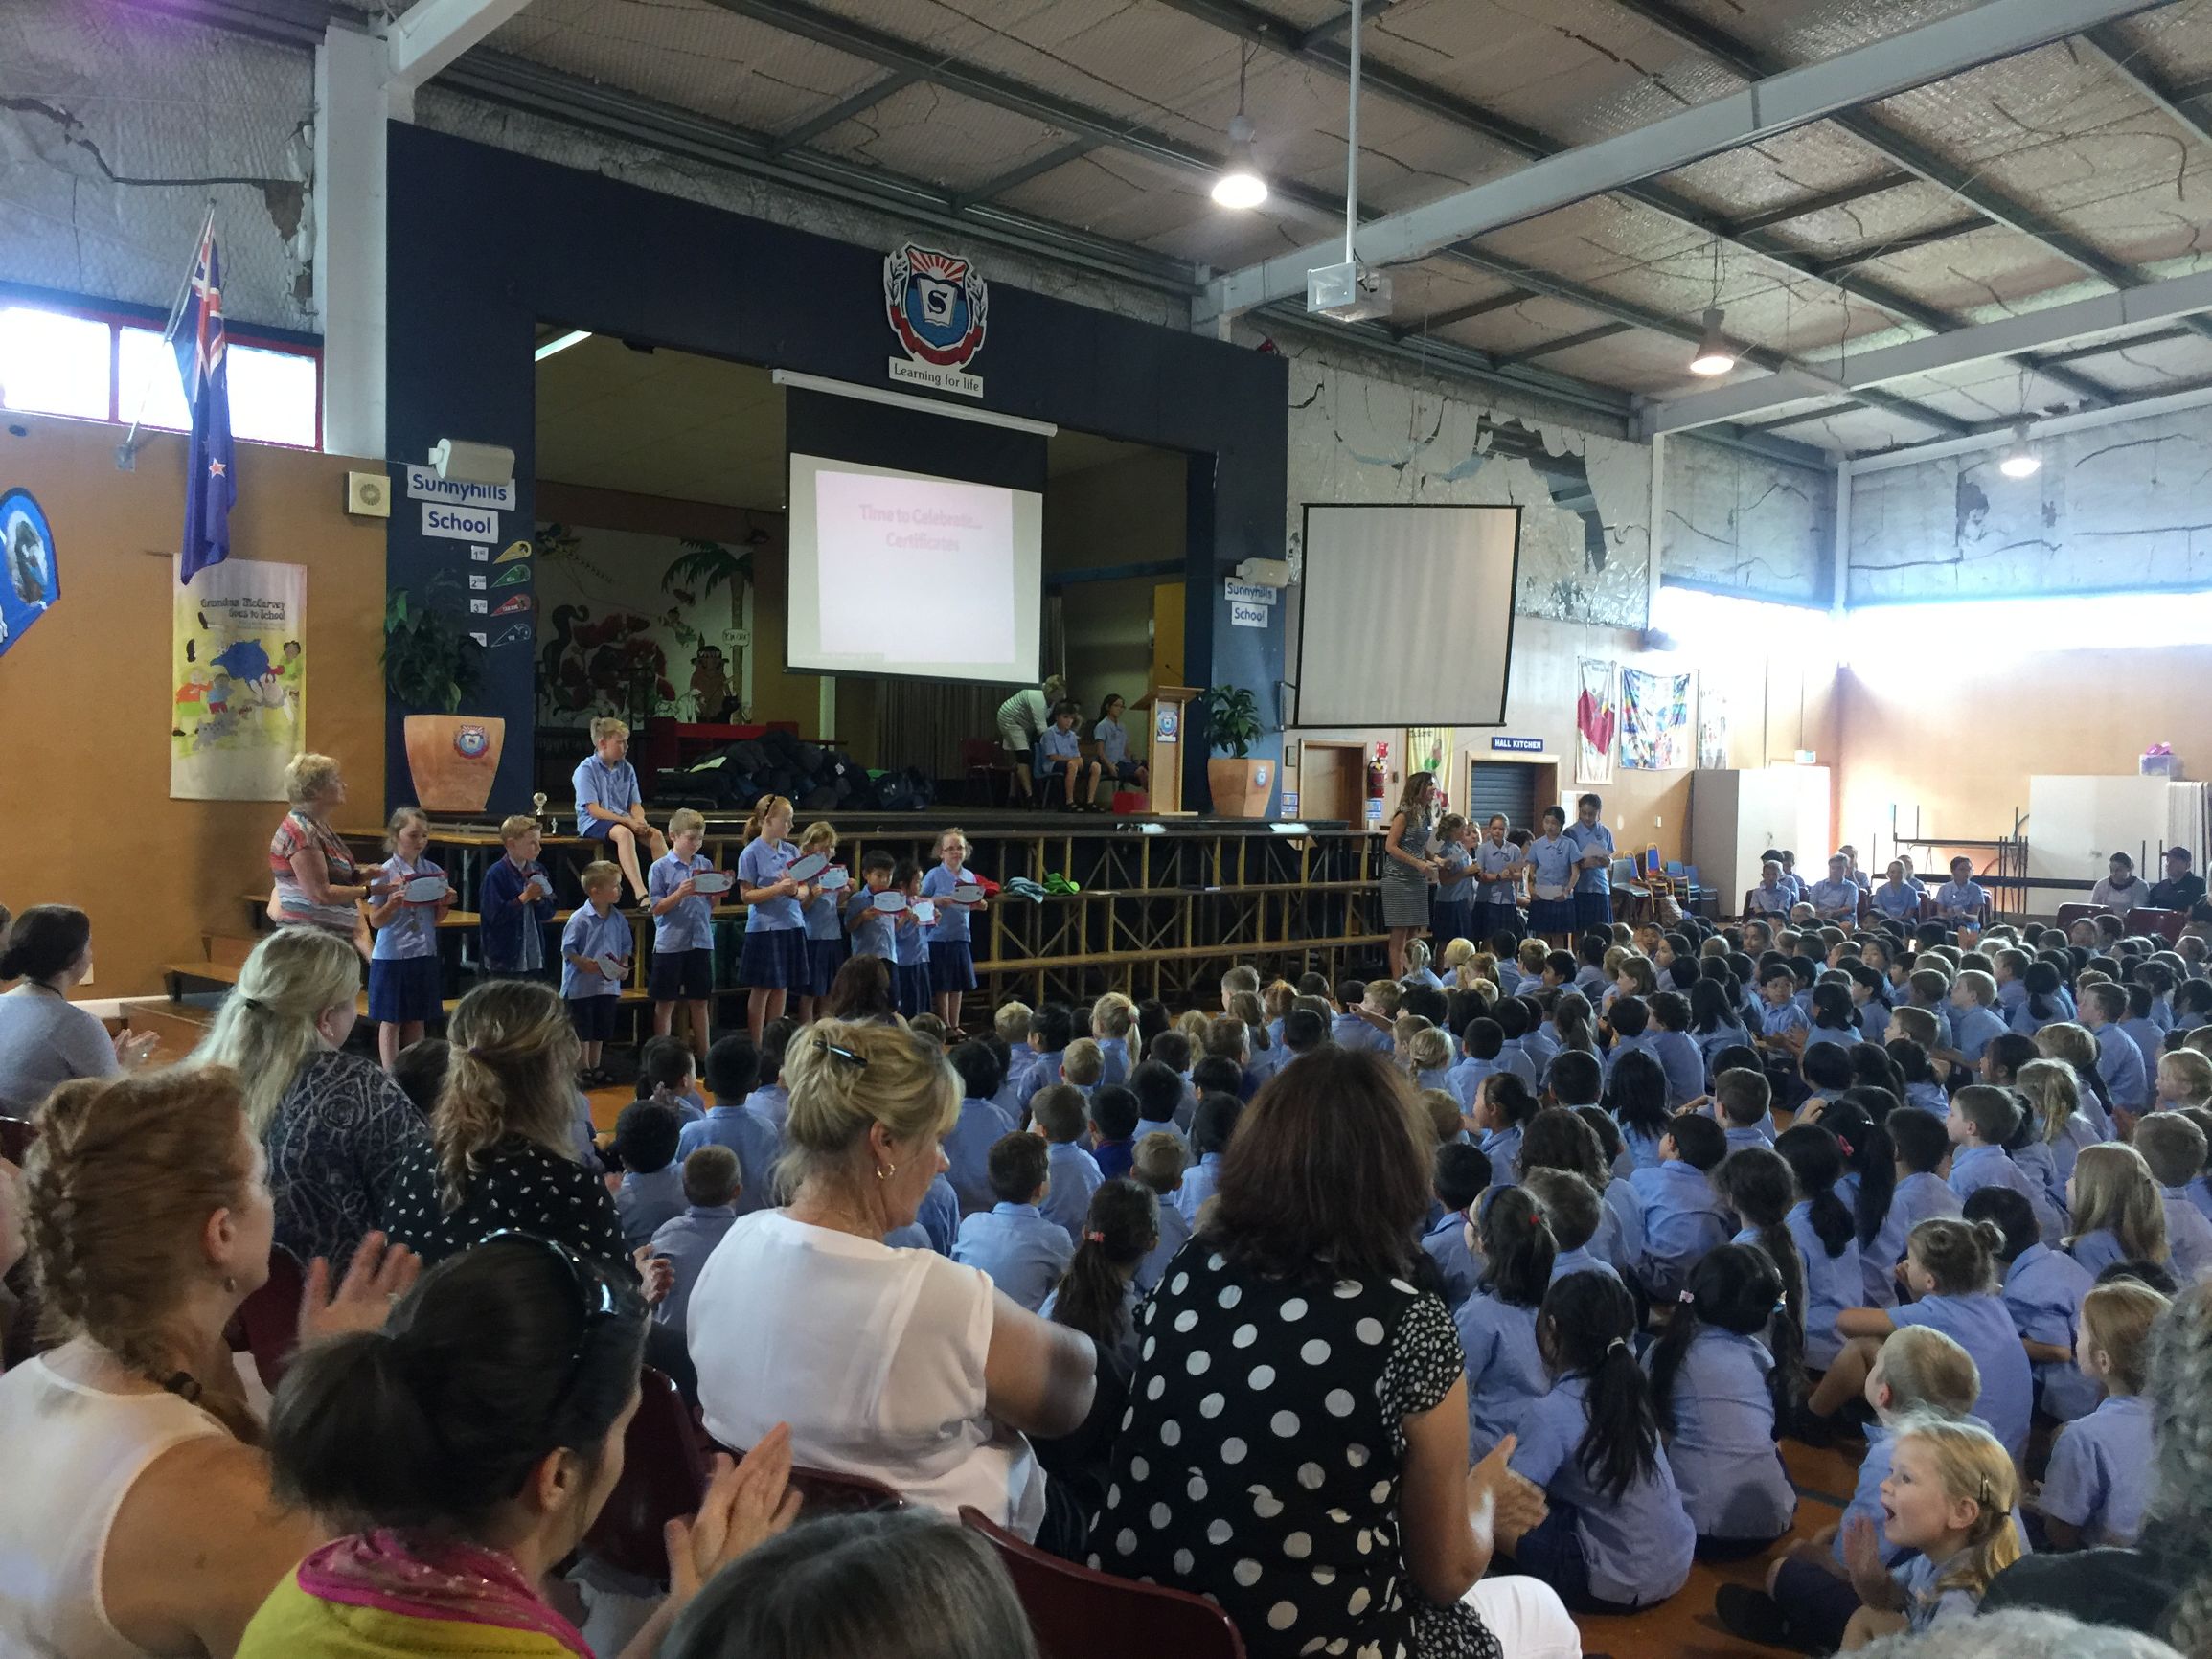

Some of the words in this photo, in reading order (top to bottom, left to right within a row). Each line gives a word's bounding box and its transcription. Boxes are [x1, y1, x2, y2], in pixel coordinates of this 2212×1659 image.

[894, 363, 941, 386] Learning
[945, 374, 960, 387] for
[963, 377, 979, 392] life
[413, 473, 507, 501] Sunnyhills
[428, 511, 490, 534] School
[858, 504, 894, 522] Time
[896, 509, 910, 523] to
[261, 610, 285, 621] School
[1234, 607, 1265, 623] School
[1494, 739, 1511, 748] HALL
[1513, 740, 1541, 749] KITCHEN
